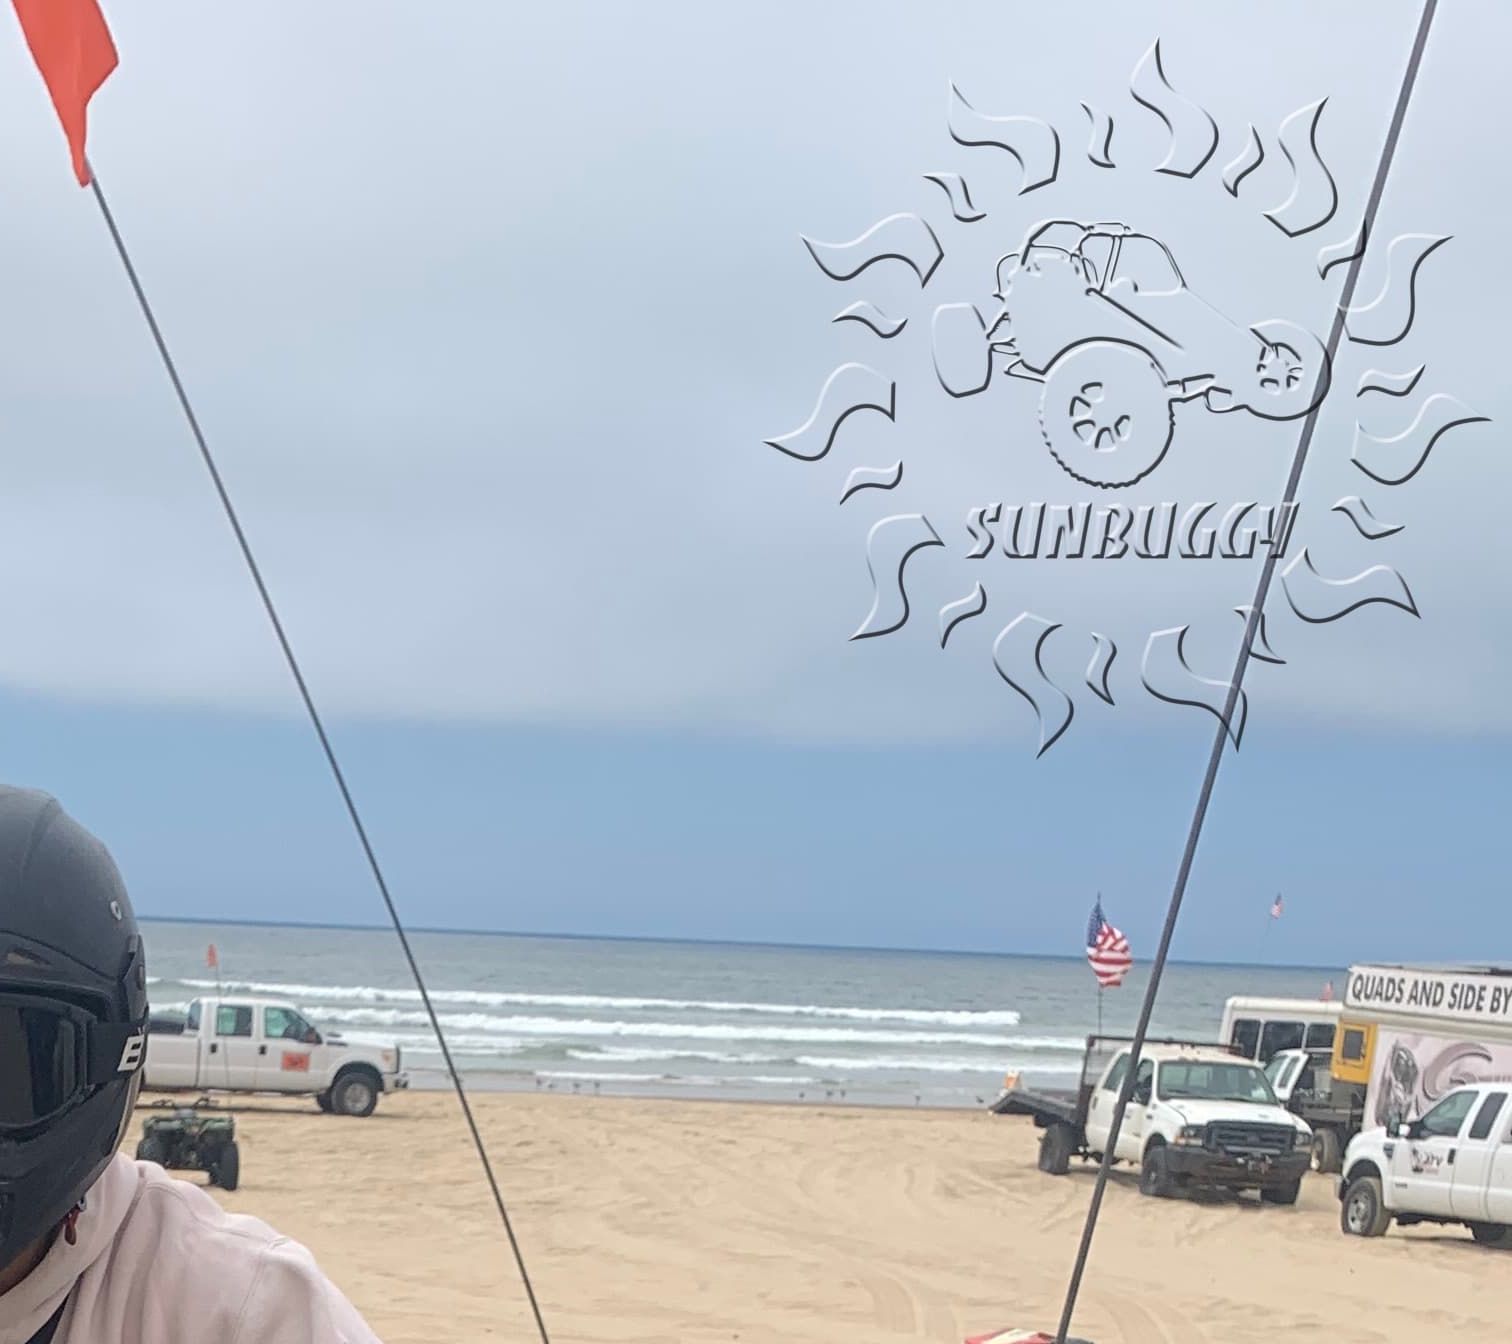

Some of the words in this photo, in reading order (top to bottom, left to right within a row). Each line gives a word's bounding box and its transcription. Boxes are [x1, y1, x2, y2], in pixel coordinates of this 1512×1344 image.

[1352, 974, 1405, 1004] QUADS
[1407, 978, 1445, 1009] AND
[1447, 982, 1487, 1012] SIDE
[1489, 986, 1512, 1015] BY
